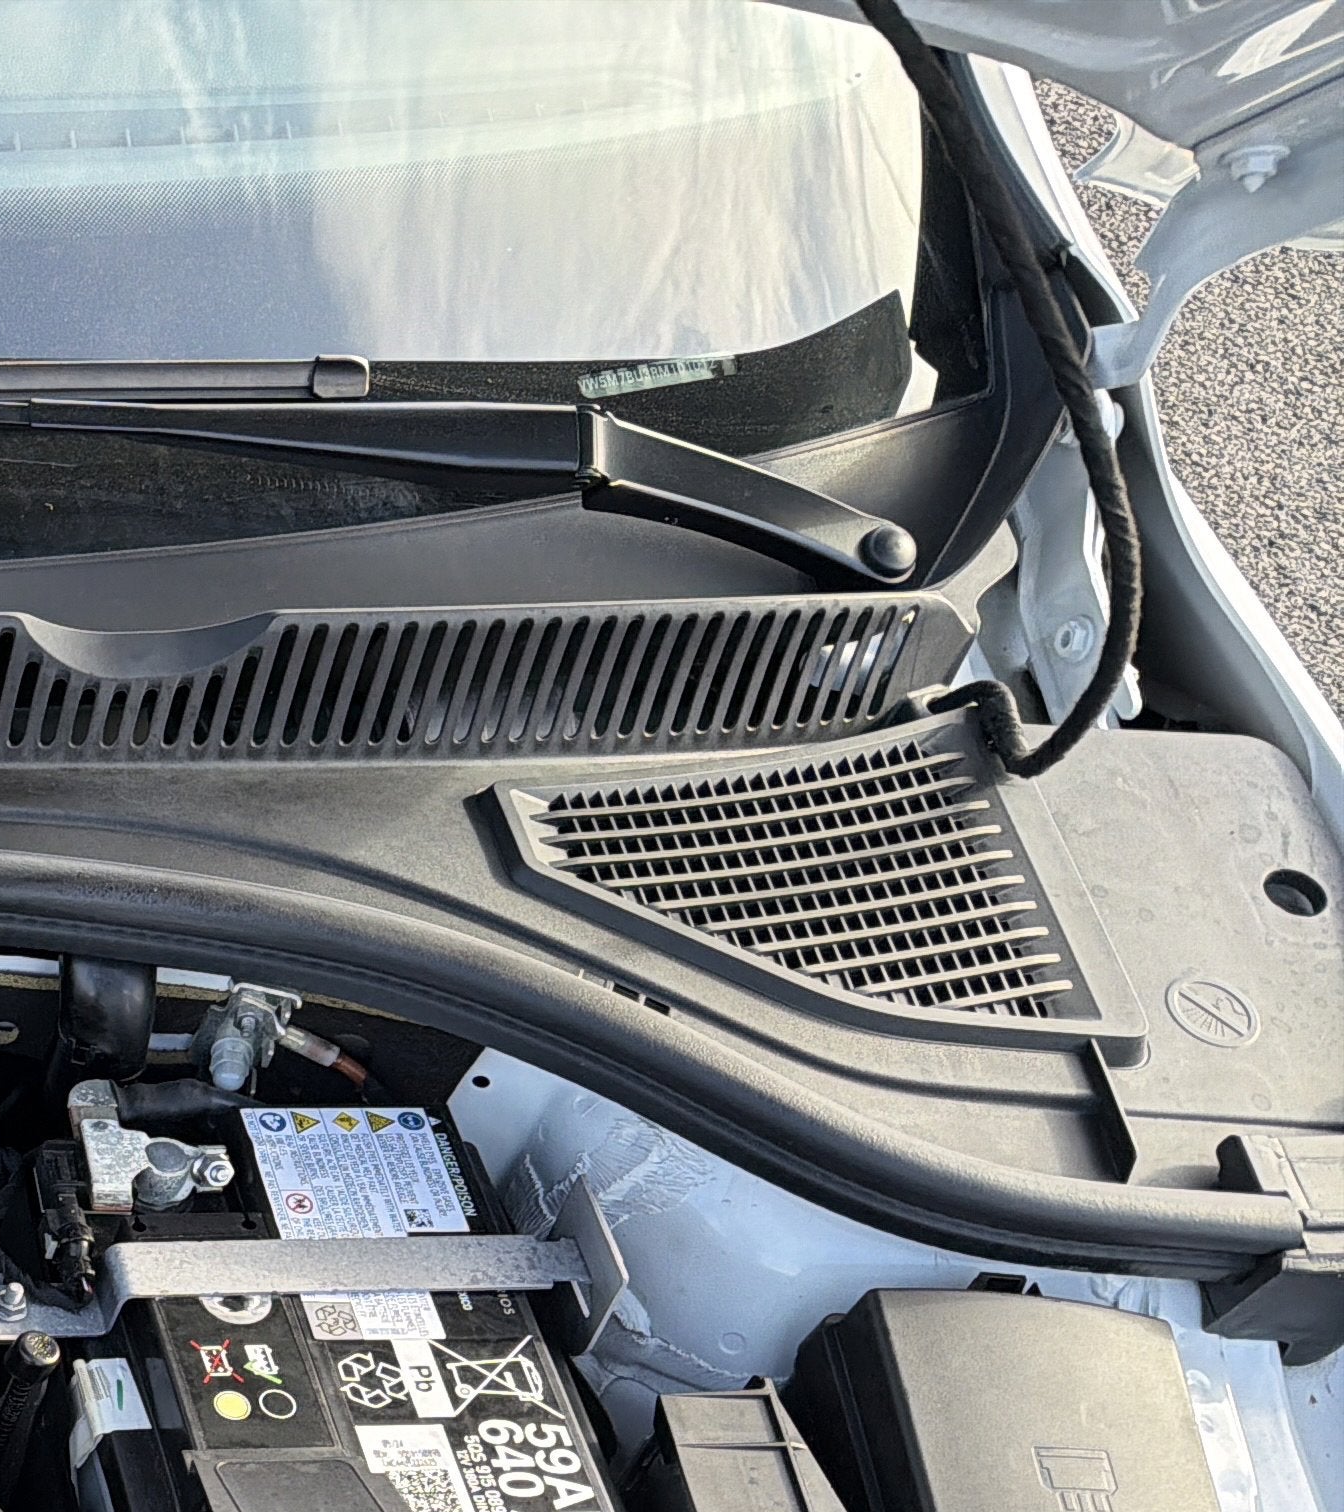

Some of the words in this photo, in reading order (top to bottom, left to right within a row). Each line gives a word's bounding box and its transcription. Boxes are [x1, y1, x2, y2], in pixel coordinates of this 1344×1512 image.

[434, 1132, 478, 1216] DANGER/POISON
[408, 1366, 436, 1392] Pb
[476, 1465, 497, 1488] 915
[478, 1419, 545, 1497] 640
